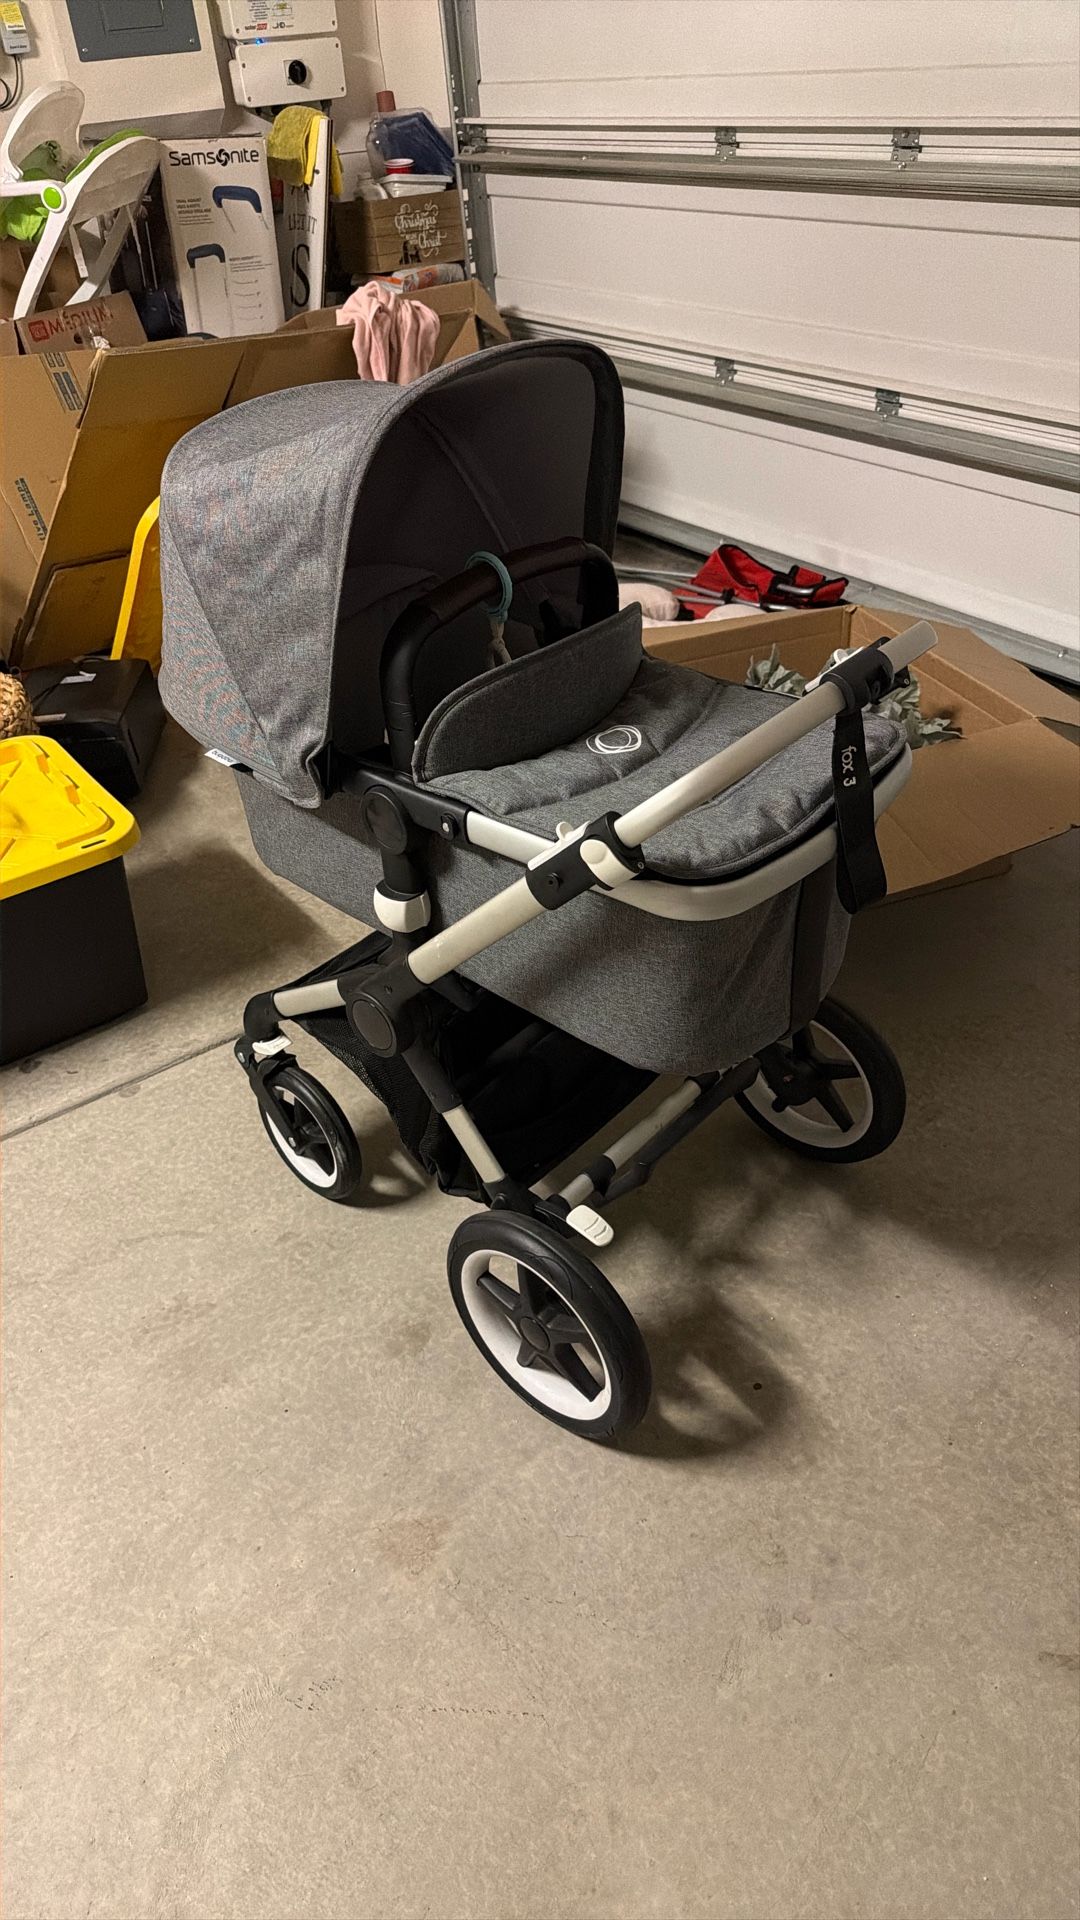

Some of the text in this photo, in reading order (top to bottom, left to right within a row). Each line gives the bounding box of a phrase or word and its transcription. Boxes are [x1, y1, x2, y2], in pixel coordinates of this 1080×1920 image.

[169, 148, 259, 167] Samsonite
[47, 303, 114, 336] MEDIUM
[14, 479, 35, 517] Lamps
[841, 745, 857, 787] fox 3
